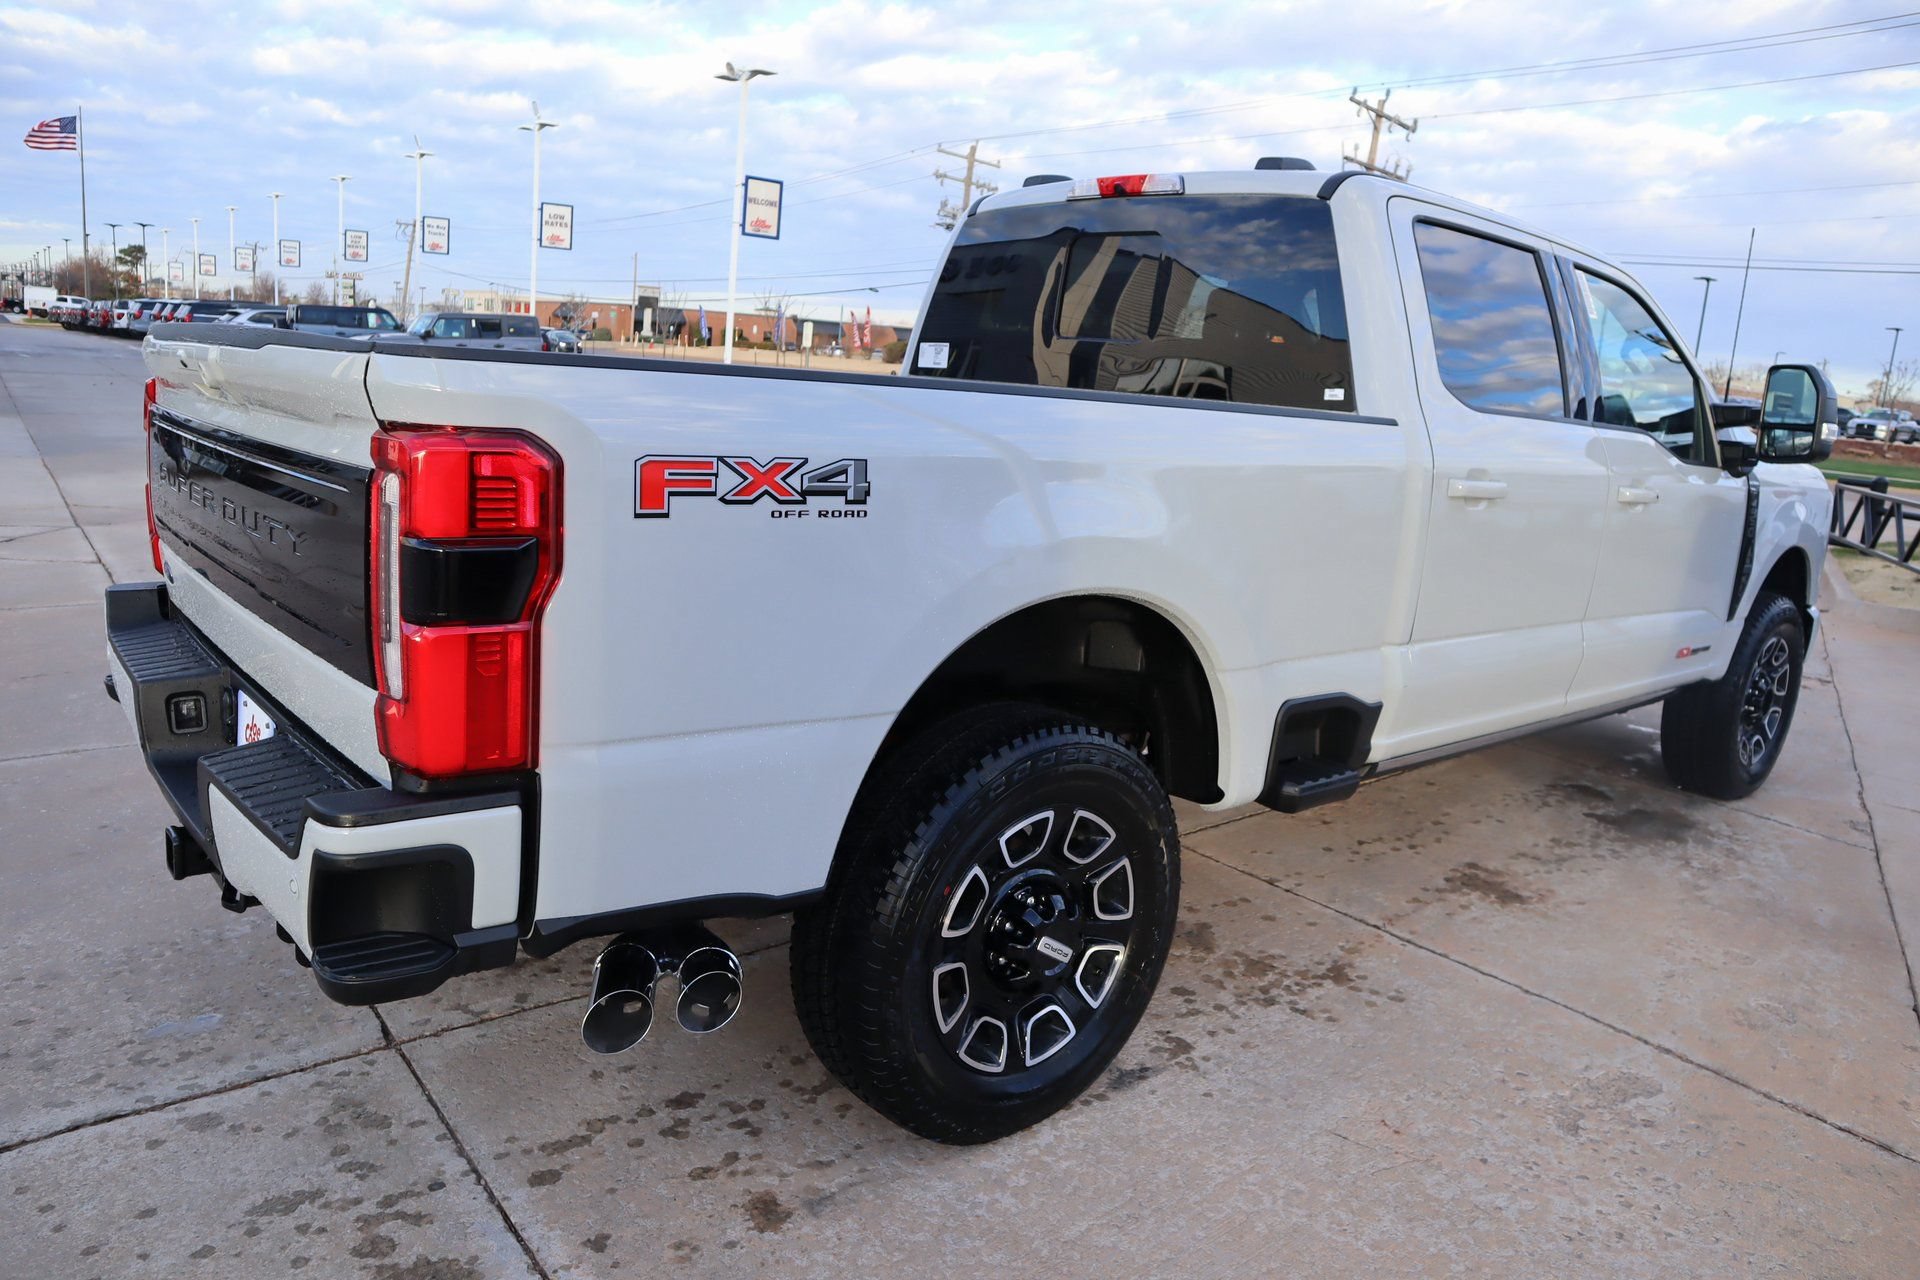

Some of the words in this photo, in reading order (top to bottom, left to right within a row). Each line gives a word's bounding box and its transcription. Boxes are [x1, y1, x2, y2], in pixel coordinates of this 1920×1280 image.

[748, 196, 778, 208] WELCOME
[548, 212, 566, 221] LOW
[544, 220, 569, 229] RATES
[634, 454, 870, 519] FX4
[159, 462, 217, 515] SUPER
[222, 496, 308, 557] DUTY
[770, 509, 810, 519] OFF
[817, 509, 868, 519] ROAD
[1043, 942, 1069, 958] FORD
